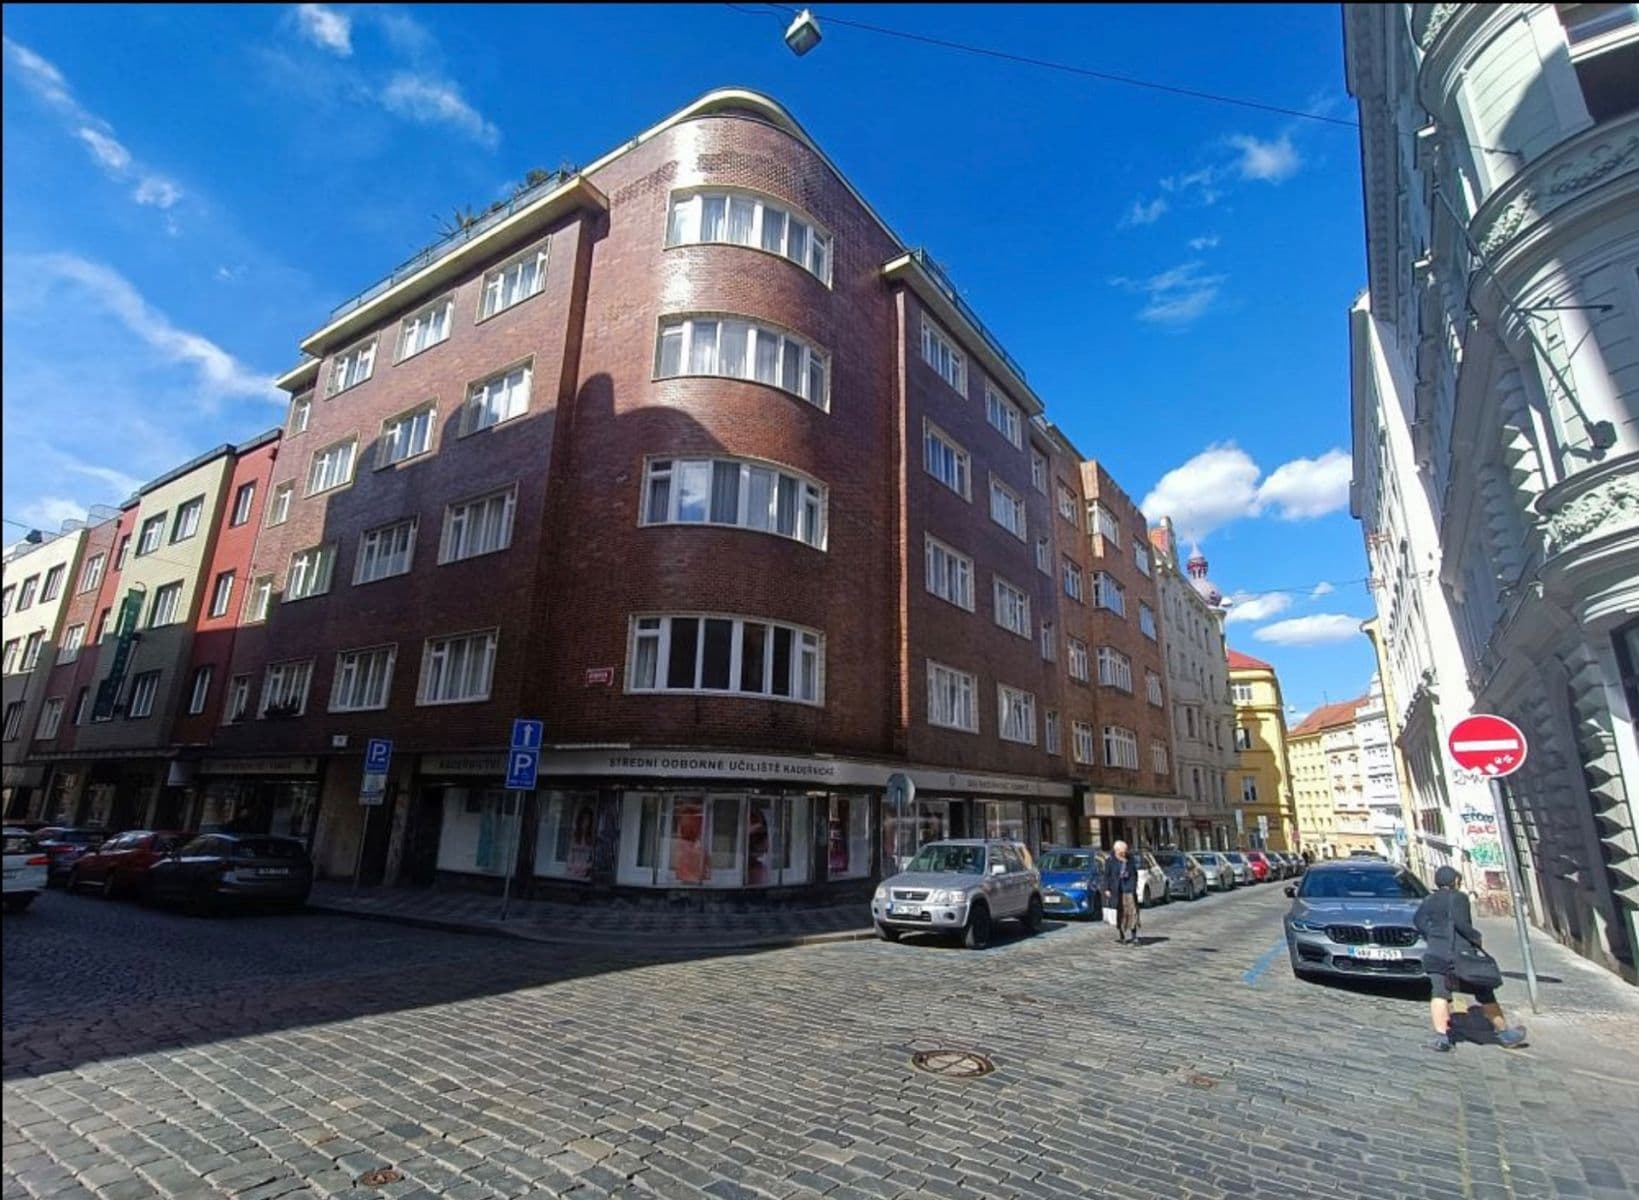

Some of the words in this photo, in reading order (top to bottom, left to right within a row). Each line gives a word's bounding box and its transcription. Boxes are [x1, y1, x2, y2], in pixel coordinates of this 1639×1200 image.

[372, 742, 387, 762] P
[514, 753, 533, 776] P
[608, 756, 658, 768] STŘEDNÍ
[728, 759, 780, 774] UČILIŠTĚ
